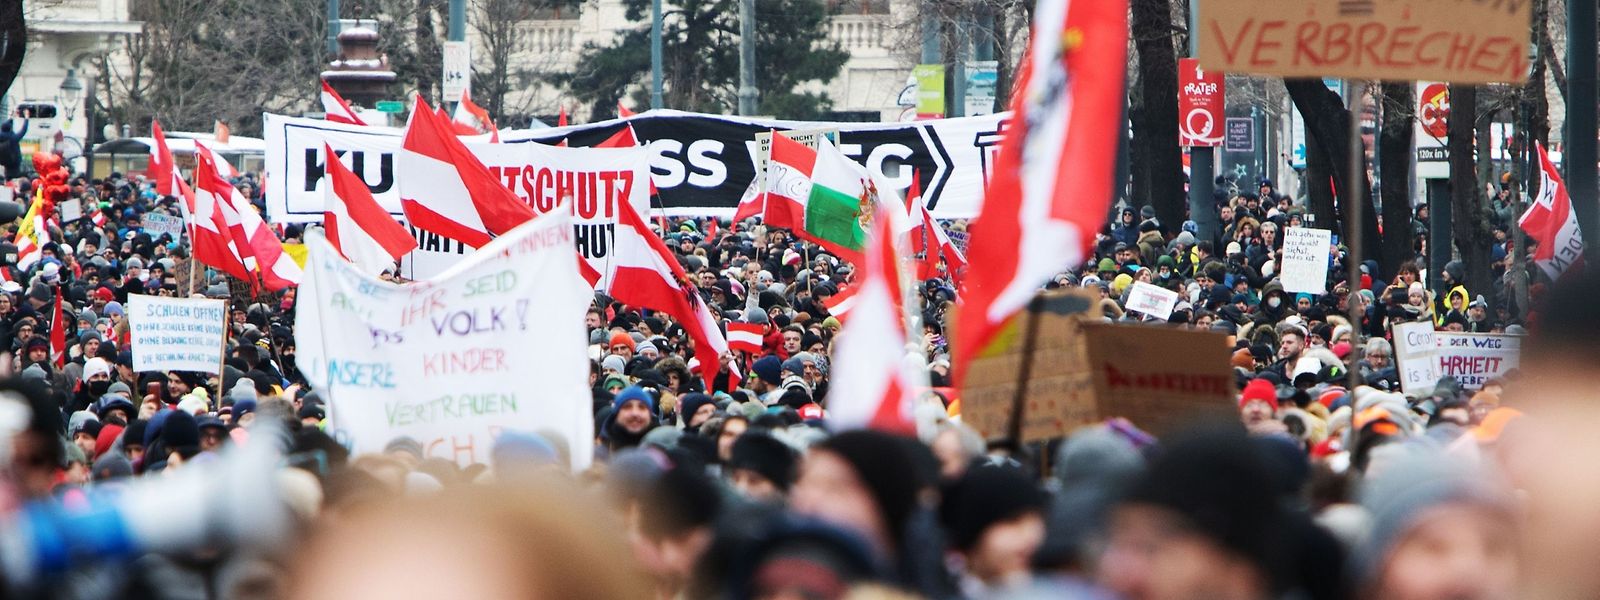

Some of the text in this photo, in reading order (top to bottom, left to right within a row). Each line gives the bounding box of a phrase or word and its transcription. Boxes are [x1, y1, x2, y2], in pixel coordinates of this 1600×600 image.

[1207, 18, 1530, 80] VERBRECHEN
[1184, 82, 1218, 96] PRATER
[304, 148, 394, 194] KU
[649, 138, 728, 189] SS
[1435, 149, 1444, 159] in
[400, 287, 448, 327] IHR
[462, 269, 518, 298] SEID
[146, 303, 190, 318] SCHULEN
[1450, 337, 1502, 349] DER WEG
[423, 349, 509, 378] KINDER
[1440, 355, 1503, 375] HRHEIT
[385, 393, 518, 427] VERTRAUEN
